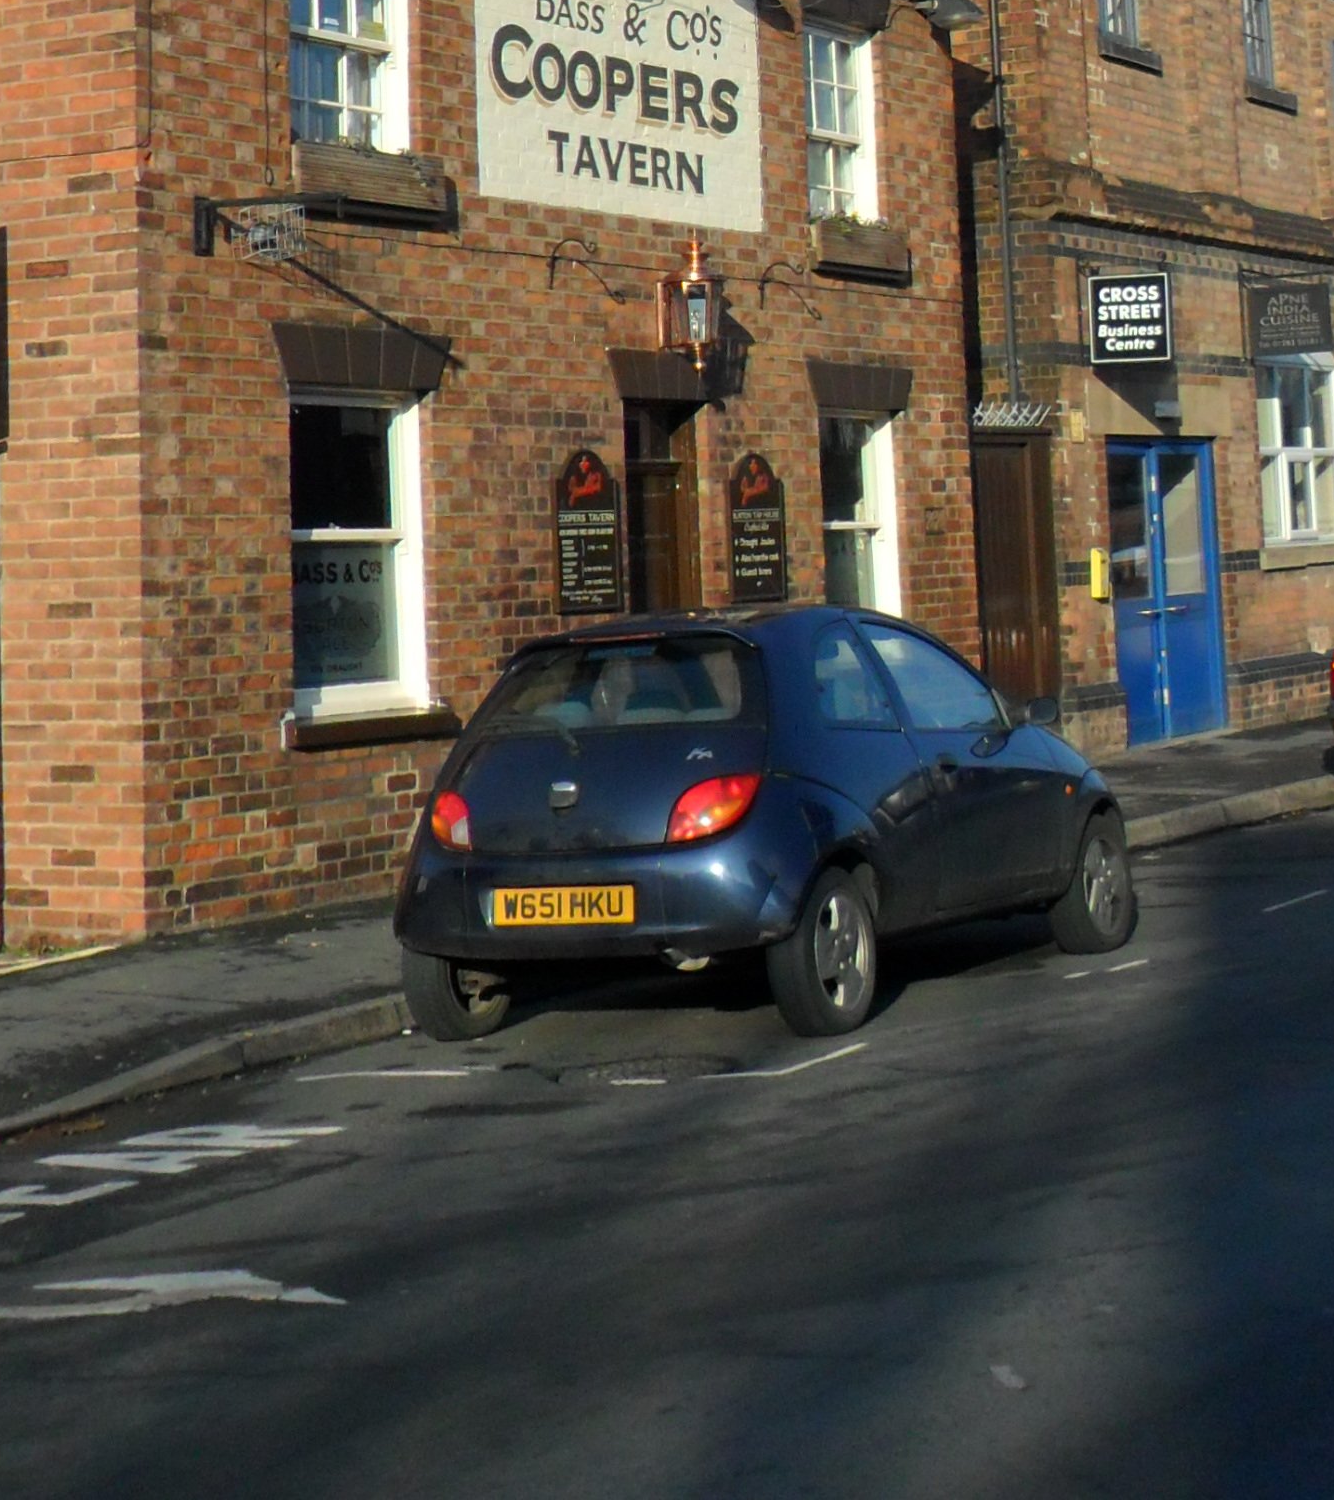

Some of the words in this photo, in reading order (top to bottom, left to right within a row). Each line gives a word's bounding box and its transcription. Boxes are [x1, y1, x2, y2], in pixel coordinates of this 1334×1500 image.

[623, 2, 647, 46] &
[490, 23, 740, 137] COOPERS
[548, 129, 705, 196] TAVERN
[1099, 285, 1160, 303] CROSS
[1267, 292, 1309, 307] APNE
[1098, 303, 1162, 321] STREET
[1267, 304, 1311, 316] INDIA
[1259, 312, 1320, 327] CUISINE
[1098, 323, 1164, 338] Business
[1105, 338, 1156, 352] Centre
[588, 512, 615, 522] TAVERN
[343, 562, 355, 584] &
[504, 892, 563, 919] W651
[569, 891, 624, 918] HKU
